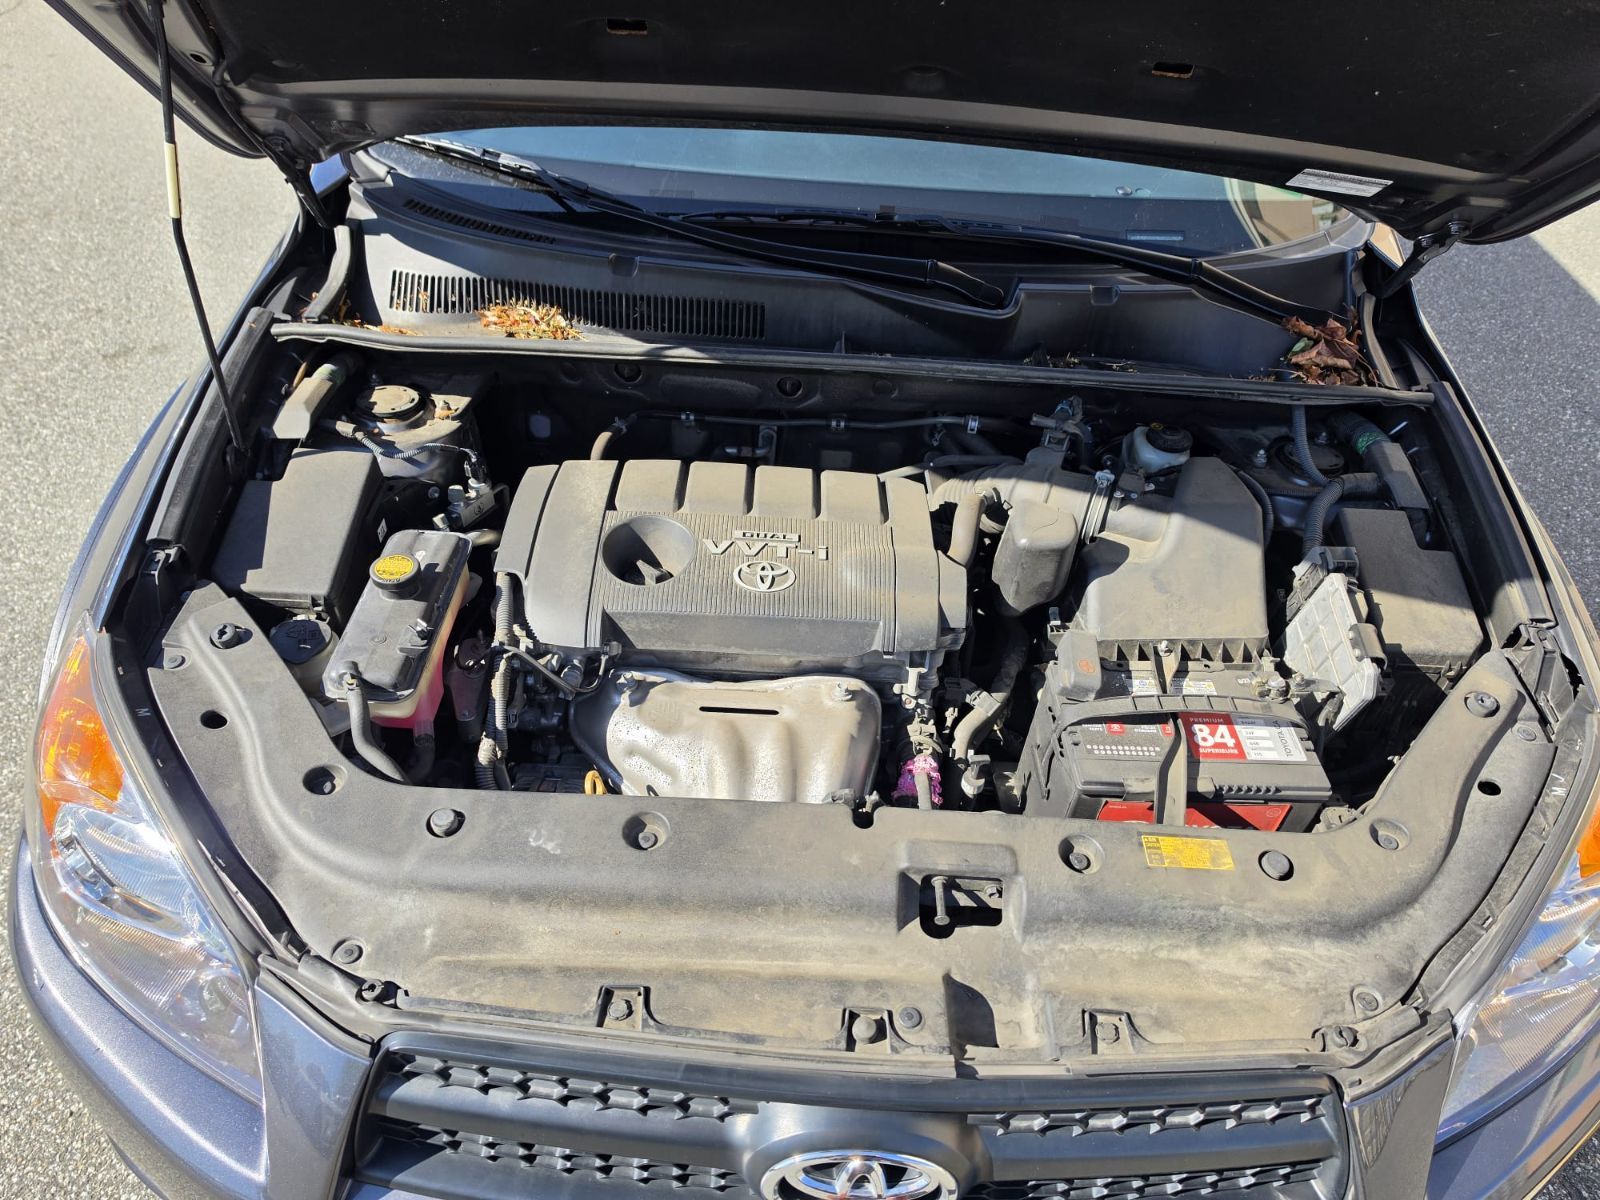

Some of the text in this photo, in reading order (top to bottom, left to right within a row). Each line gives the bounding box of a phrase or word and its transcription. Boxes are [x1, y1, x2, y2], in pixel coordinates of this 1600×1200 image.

[741, 531, 796, 540] DUAL
[702, 538, 828, 560] VVT-i
[1191, 723, 1236, 748] 84
